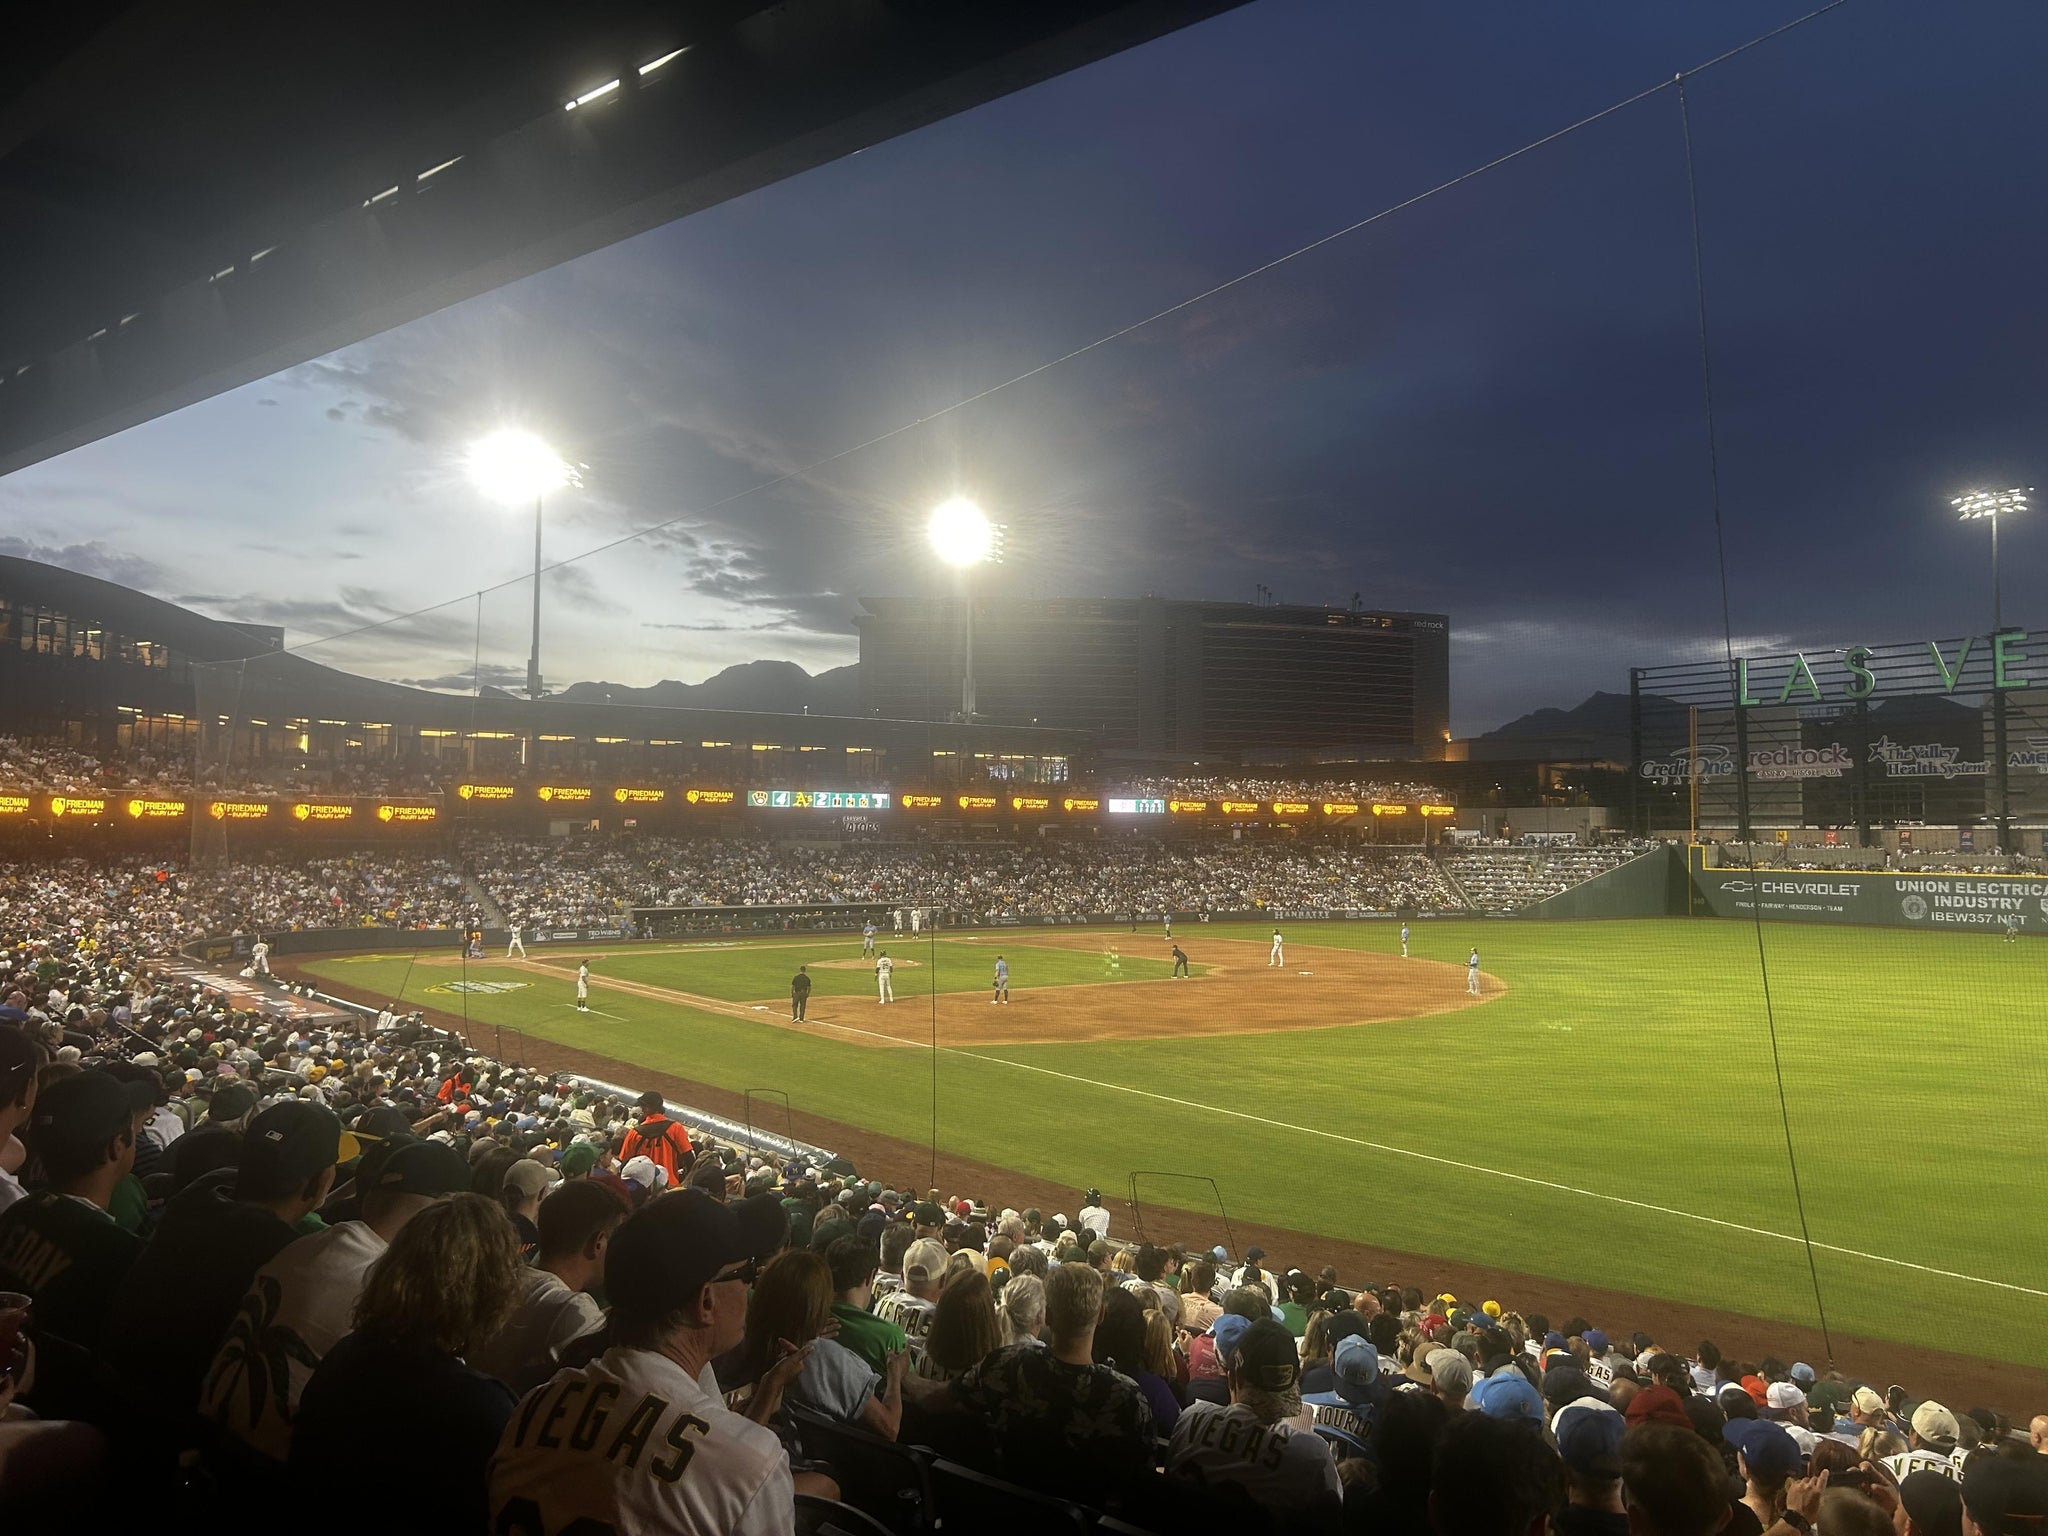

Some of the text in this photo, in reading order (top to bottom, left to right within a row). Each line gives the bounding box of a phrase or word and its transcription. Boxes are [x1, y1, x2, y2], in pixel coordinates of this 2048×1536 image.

[1739, 632, 2030, 706] LAS VE
[1911, 744, 1959, 762] Valley
[2008, 752, 2048, 765] AME
[1888, 761, 1937, 775] Health
[474, 787, 513, 795] FRIEDMAN
[553, 788, 590, 796] FRIEDMAN
[628, 790, 664, 798] FRIEDMAN
[700, 791, 733, 799] FRIEDMAN
[66, 799, 104, 809] FRIEDMAN
[775, 792, 786, 805] 4
[816, 792, 827, 806] 2
[145, 802, 185, 811] FRIEDMAN
[227, 804, 268, 813] FRIEDMAN
[311, 805, 352, 814] FRIEDMAN
[395, 807, 436, 816] FRIEDMAN
[1762, 882, 1860, 896] CHEVROLET
[1895, 881, 1949, 892] UNION
[1934, 896, 2024, 909] INDUSTRY
[1931, 912, 2027, 925] IBEW357.NT
[1584, 1363, 1611, 1381] GAS
[1315, 1405, 1373, 1438] HOURIO
[515, 1381, 711, 1484] VEGAS
[1189, 1412, 1289, 1472] VEGAS
